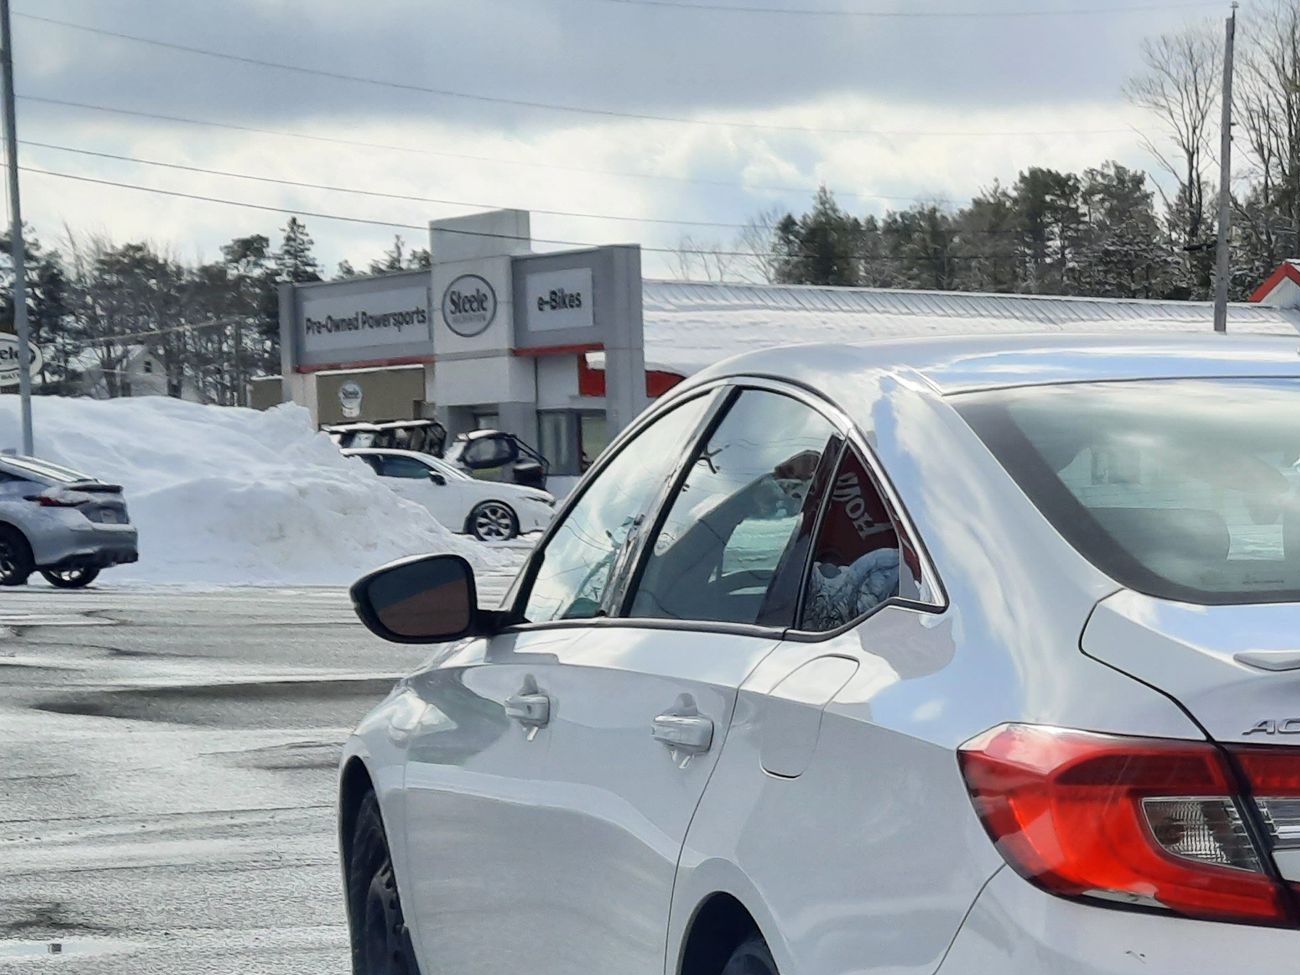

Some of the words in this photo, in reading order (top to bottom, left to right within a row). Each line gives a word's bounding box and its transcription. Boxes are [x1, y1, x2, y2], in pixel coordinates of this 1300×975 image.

[449, 288, 489, 315] Steele
[537, 288, 582, 312] e-Bikes
[305, 311, 360, 335] Pre-Owned
[361, 306, 427, 333] Powersports
